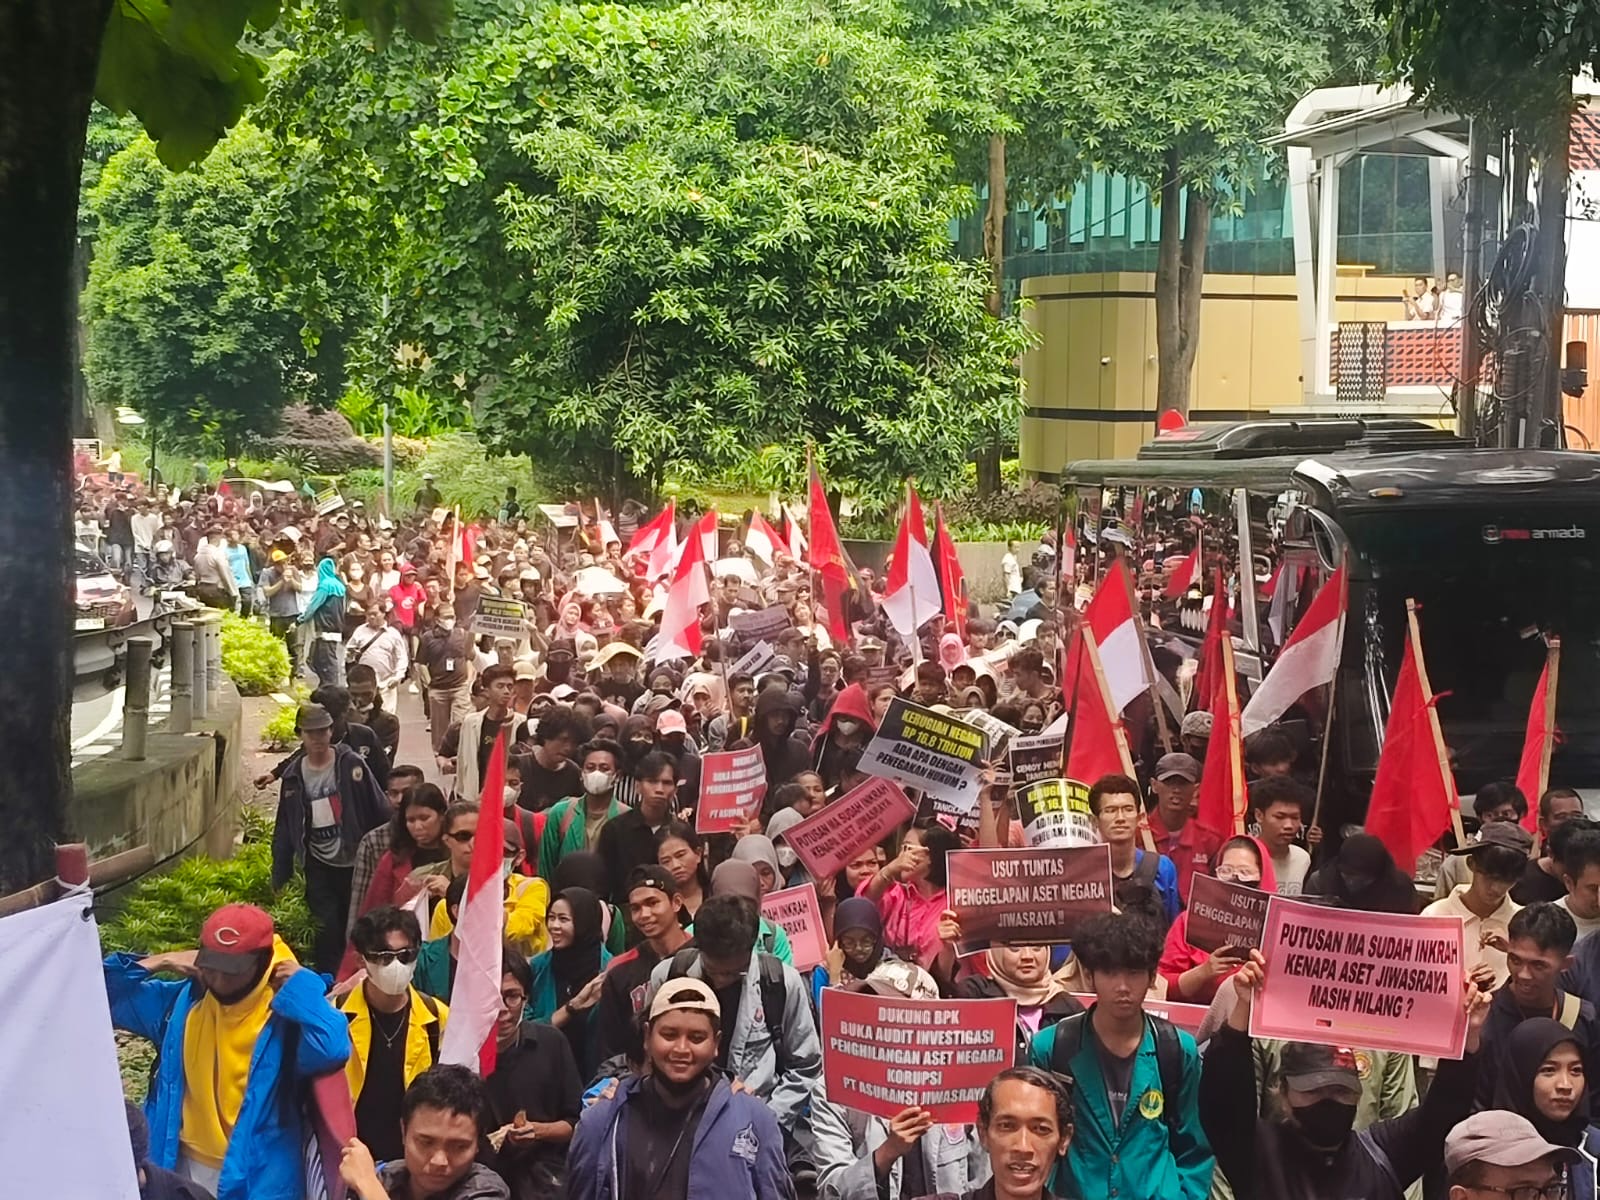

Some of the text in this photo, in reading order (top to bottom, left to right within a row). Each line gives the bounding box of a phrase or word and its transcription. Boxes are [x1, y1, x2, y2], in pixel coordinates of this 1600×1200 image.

[1532, 524, 1585, 539] armada
[902, 709, 949, 736] KERUGIAN
[902, 726, 975, 760] RP 16.8 TRILIUN
[875, 752, 968, 791] PENEGAKAN HUKUM ?
[892, 742, 966, 776] ADA APA DENGAN
[795, 823, 830, 848] PUTUSAN
[828, 816, 842, 830] MA
[838, 801, 864, 824] SUDAH
[810, 838, 841, 859] KENAPA
[992, 858, 1064, 878] USUT TUNTAS
[954, 882, 1105, 906] PENGGELAPAN ASET NEGARA
[1230, 893, 1256, 911] USUT
[779, 899, 809, 918] INKRAH
[998, 911, 1056, 927] JIWASRAYA
[1194, 902, 1259, 931] PENGGELAPAN
[1279, 923, 1458, 965] PUTUSAN MA SUDAH INKRAH
[1284, 953, 1448, 995] KENAPA ASET JIWASRAYA
[878, 1006, 960, 1025] DUKUNG BPK
[1308, 985, 1414, 1019] MASIH HILANG ?
[840, 1021, 994, 1046] BUKA AUDIT INVESTIGASI
[830, 1036, 1004, 1066] PENGHILANGAN ASET NEGARA
[887, 1068, 942, 1086] KORUPSI
[843, 1077, 856, 1091] PT
[859, 1081, 918, 1107] ASURANSI
